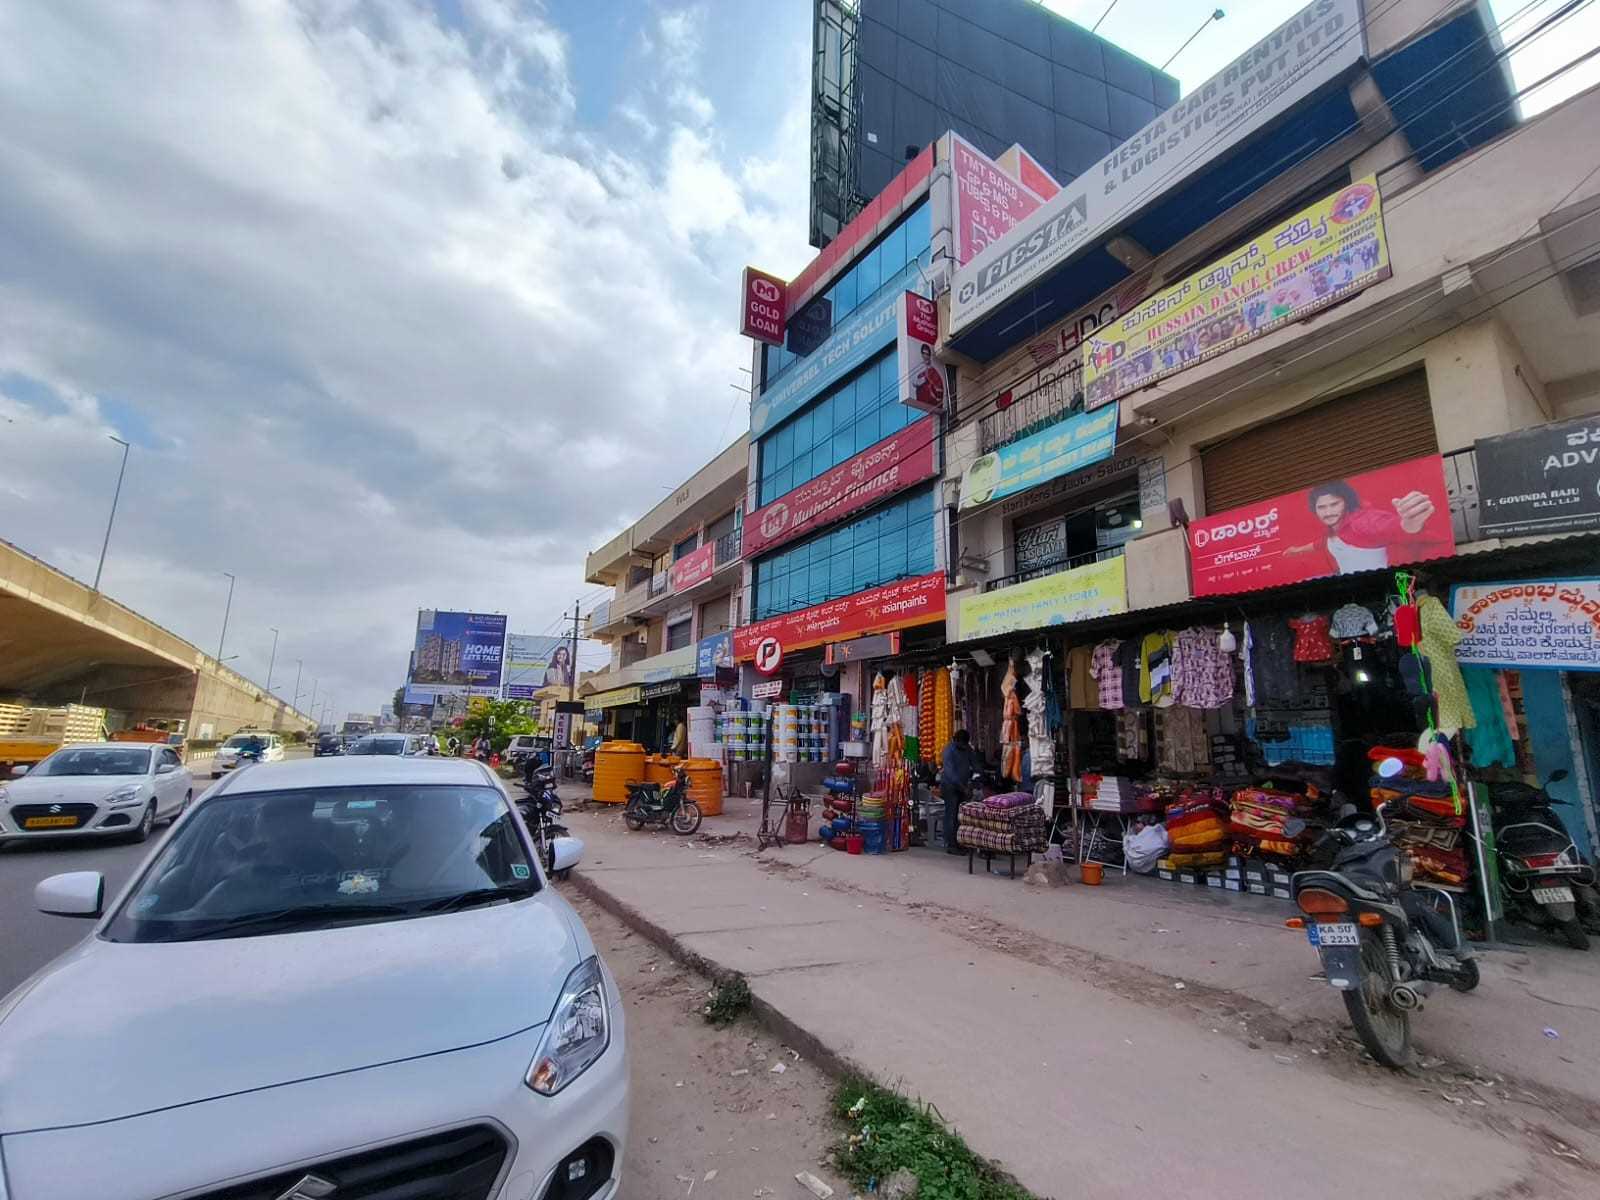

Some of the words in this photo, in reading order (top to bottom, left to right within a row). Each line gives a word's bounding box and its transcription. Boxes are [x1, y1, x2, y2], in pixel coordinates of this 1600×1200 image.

[1103, 121, 1168, 177] FIESTA
[1172, 80, 1217, 125] CAR
[1223, 0, 1336, 87] RENTALS
[1104, 181, 1118, 196] &
[1122, 90, 1235, 185] LOGISTICS
[1241, 48, 1291, 98] PVT
[1297, 13, 1345, 57] LTD
[960, 149, 986, 176] TMT
[1147, 303, 1206, 342] HUSSAIN
[1210, 274, 1262, 310] DANCE
[1265, 246, 1313, 283] CREW
[750, 300, 780, 321] GOLD
[749, 314, 779, 336] LOAN
[853, 301, 898, 346] SOLUTI
[1543, 448, 1600, 471] ADV
[791, 491, 842, 528] Muthoot
[843, 465, 899, 503] Finance
[1499, 491, 1547, 505] GOVINDA
[1550, 487, 1580, 498] RAJU
[1210, 508, 1278, 541] ಡಾಲರ್
[881, 594, 928, 614] asianpaints
[464, 643, 502, 656] HOME
[1319, 925, 1335, 934] KA
[1330, 935, 1357, 944] 2231
